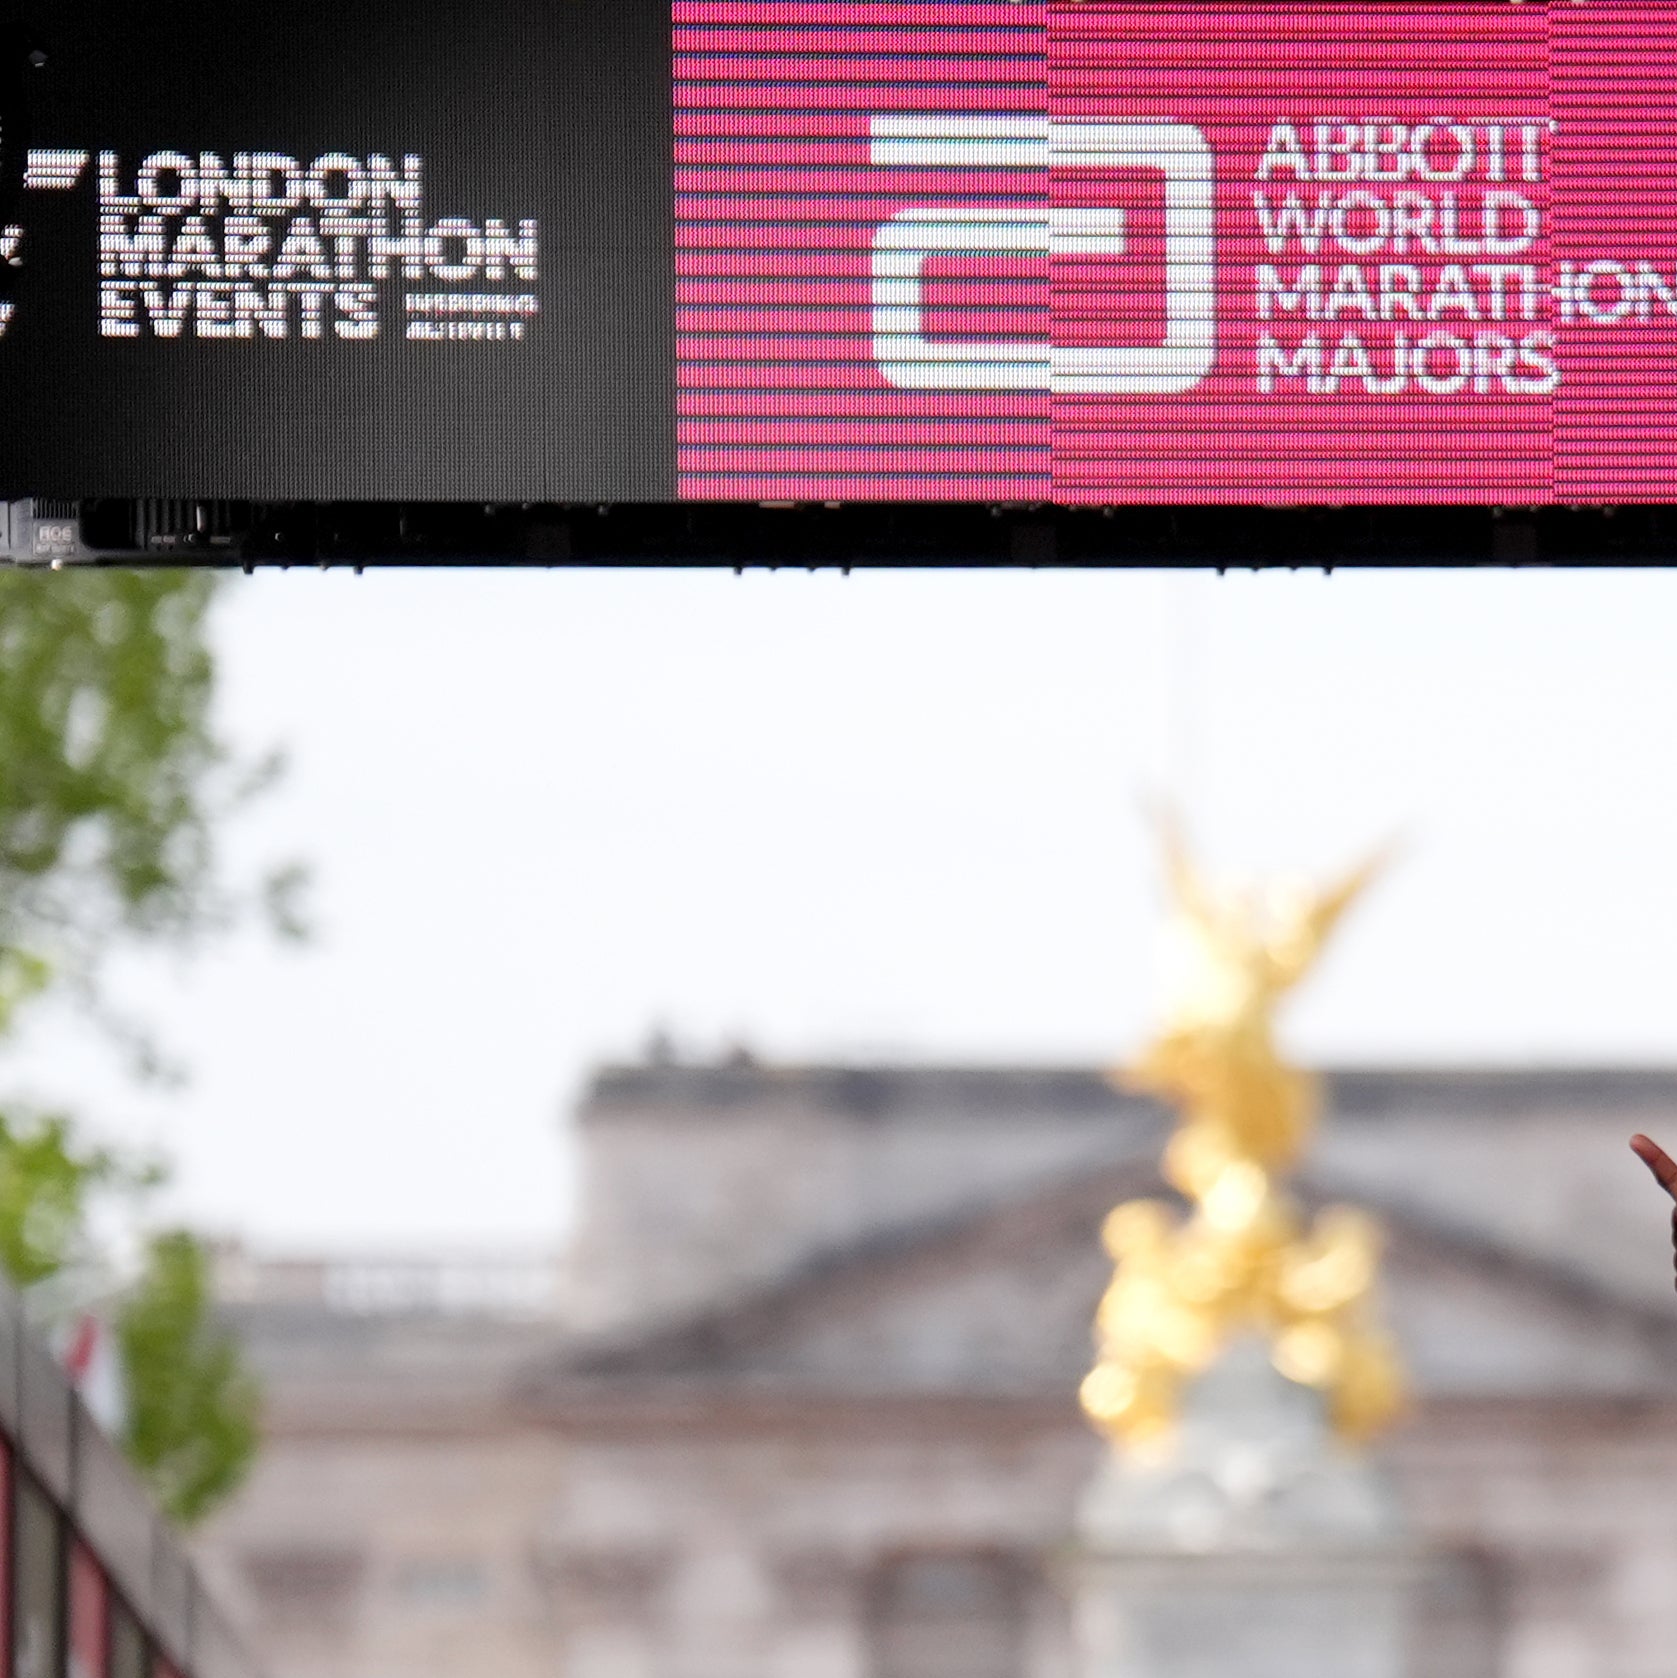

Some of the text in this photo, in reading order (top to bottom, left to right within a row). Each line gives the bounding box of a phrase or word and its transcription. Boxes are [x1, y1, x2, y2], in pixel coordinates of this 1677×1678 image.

[97, 150, 423, 214] LONDON
[1253, 116, 1558, 182] ABBOTT
[97, 215, 539, 281] MARATHON
[1252, 190, 1540, 256] WORLD
[98, 281, 379, 339] EVENTS
[1253, 330, 1561, 396] MAJORS
